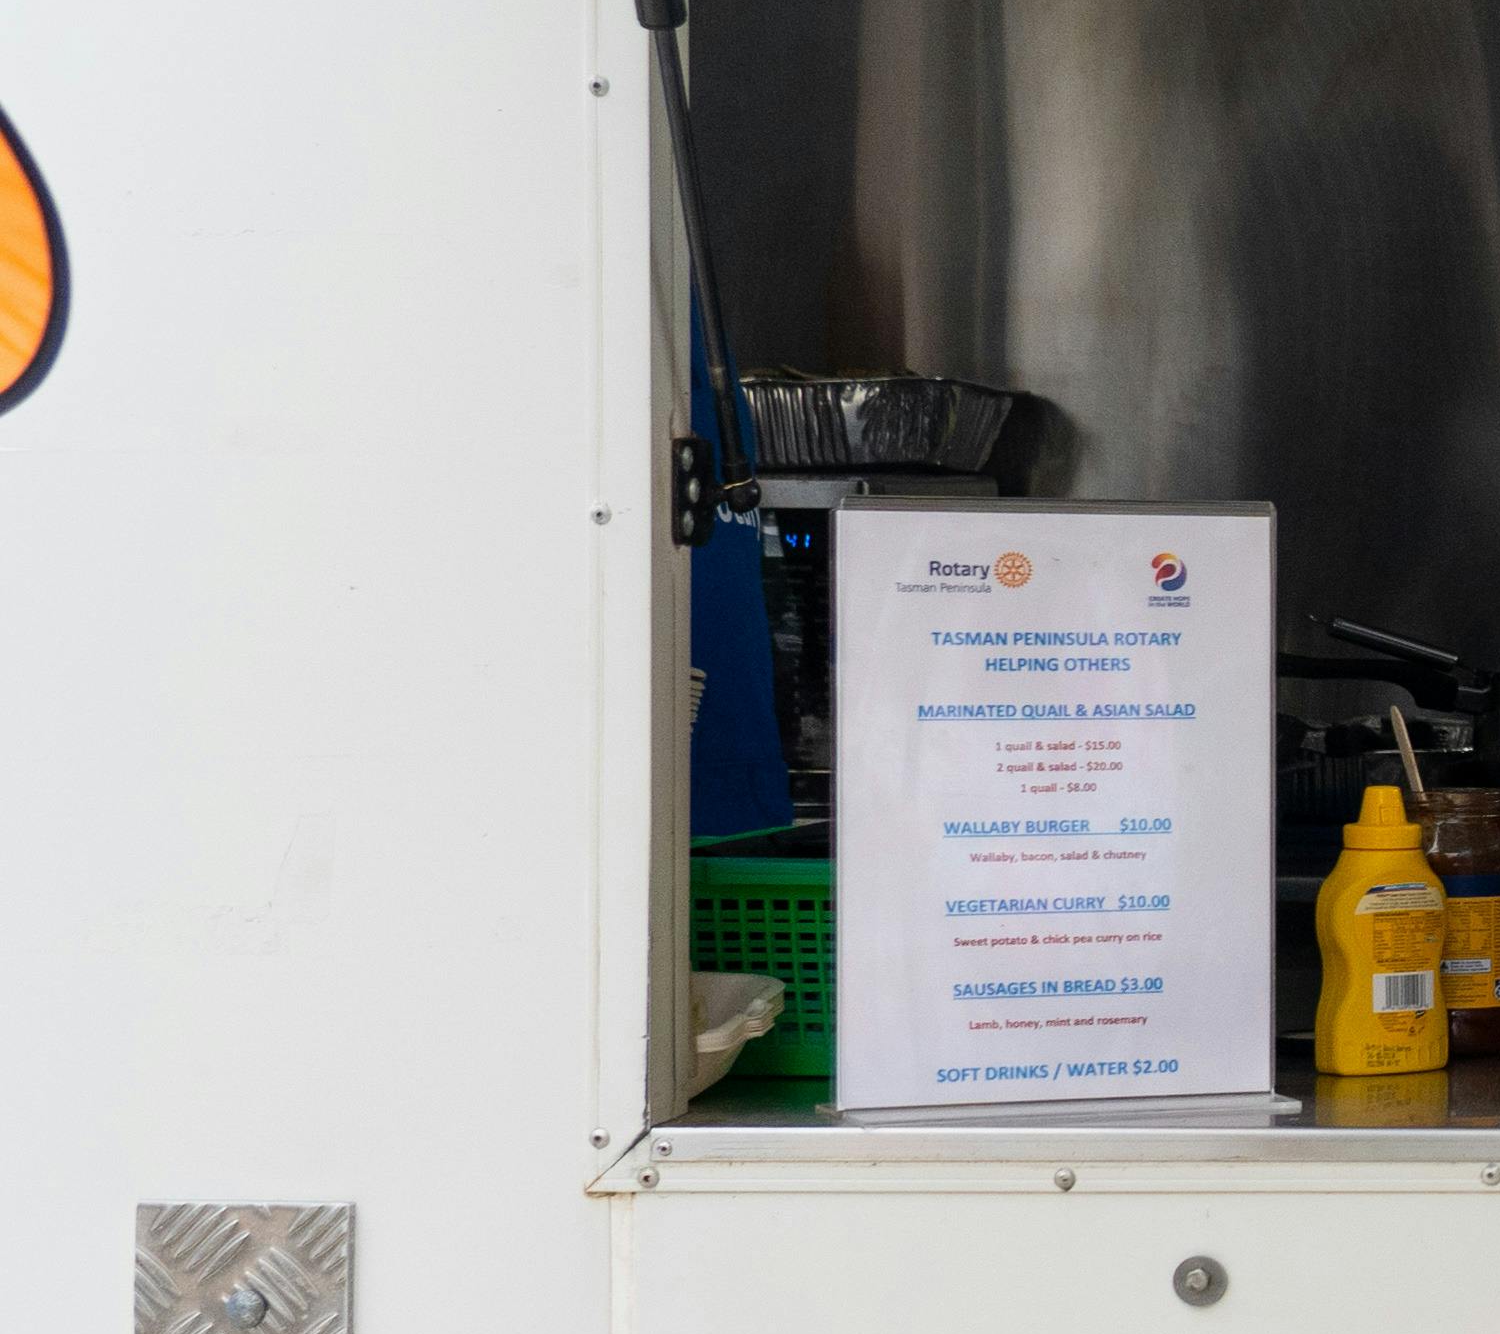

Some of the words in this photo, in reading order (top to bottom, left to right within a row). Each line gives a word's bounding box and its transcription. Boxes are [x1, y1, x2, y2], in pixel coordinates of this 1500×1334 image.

[929, 561, 990, 580] Rotary
[896, 583, 936, 593] Tasman
[940, 582, 991, 593] Peninsula
[932, 632, 1007, 646] TASMAN
[1013, 632, 1108, 646] PENINSULA
[1114, 632, 1181, 646] ROTARY
[986, 658, 1059, 672] HELPING
[1064, 658, 1131, 671] OTHERS
[918, 704, 1016, 718] MARINATED
[1022, 704, 1070, 718] QUAIL
[1076, 704, 1087, 717] &
[1093, 704, 1139, 717] ASIAN
[1145, 704, 1195, 716] SALAD
[996, 742, 1001, 750] 1
[1006, 741, 1032, 753] quail
[1035, 742, 1044, 750] &
[1047, 741, 1075, 750] salad
[1085, 741, 1121, 752] $15.00
[997, 763, 1003, 771] 2
[1007, 762, 1033, 774] quail
[1036, 763, 1045, 771] &
[1048, 762, 1076, 771] salad
[1087, 762, 1123, 773] $20.00
[1021, 784, 1027, 792] 1
[1031, 783, 1057, 795] quail
[1067, 783, 1097, 794] $8.00
[944, 821, 1020, 834] WALLABY
[1025, 820, 1090, 833] BURGER
[1120, 818, 1171, 833] $10.00
[946, 898, 1048, 914] VEGETARIAN
[1053, 897, 1105, 911] CURRY
[1118, 894, 1169, 911] $10.00
[954, 937, 988, 947] Sweet
[991, 937, 1027, 948] potato
[1031, 936, 1039, 945] &
[1043, 935, 1070, 945] chick
[1073, 937, 1093, 946] pea
[1096, 936, 1123, 946] curry
[1143, 932, 1162, 941] rice
[954, 981, 1037, 997] SAUSAGES
[1042, 980, 1058, 993] IN
[1063, 979, 1115, 992] BREAD
[1120, 977, 1163, 993] $3.00
[969, 1020, 1003, 1031] Lamb,
[1006, 1019, 1043, 1031] honey,
[1046, 1017, 1071, 1027] mint
[1075, 1017, 1094, 1026] and
[1097, 1016, 1147, 1027] rosemary
[937, 1068, 980, 1083] SOFT
[986, 1066, 1048, 1081] DRINKS
[1054, 1064, 1060, 1080] /
[1067, 1062, 1127, 1077] WATER
[1132, 1059, 1178, 1076] $2.00
